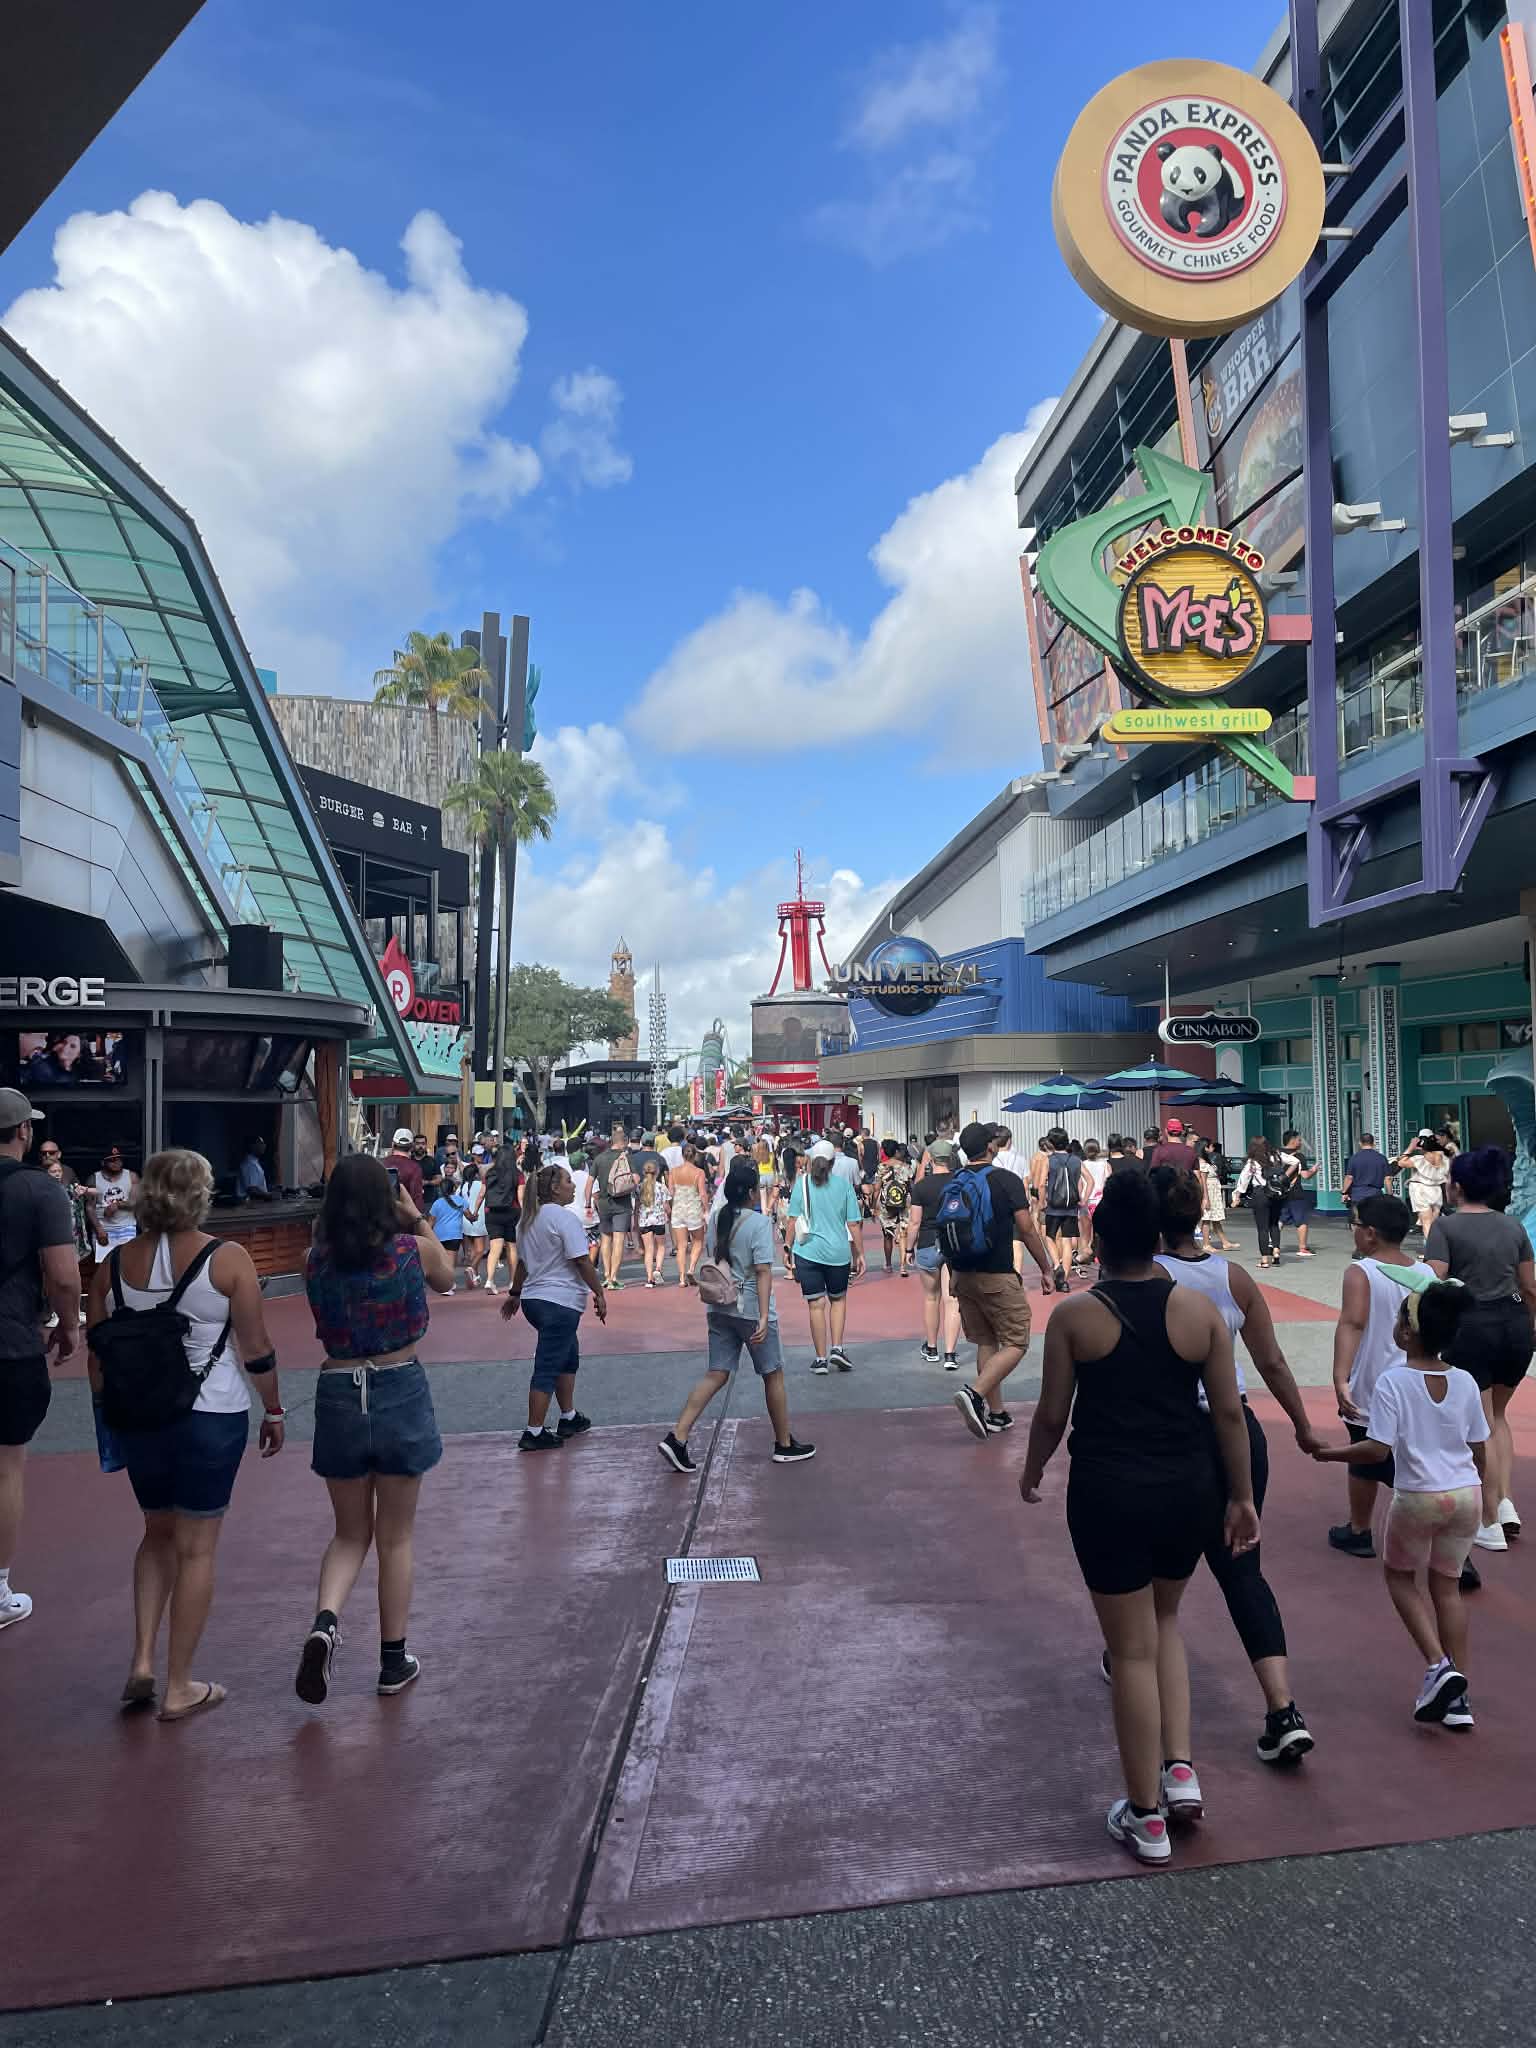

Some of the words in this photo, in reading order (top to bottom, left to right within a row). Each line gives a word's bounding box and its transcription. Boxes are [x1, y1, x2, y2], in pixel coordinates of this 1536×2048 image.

[1113, 107, 1179, 184] PANDA
[1187, 103, 1278, 186] EXPRESS
[1117, 199, 1176, 262] GOURMET
[1183, 241, 1249, 268] CHINESE
[1247, 202, 1276, 245] FOOD
[1219, 317, 1266, 384] WHOPPER
[1223, 336, 1272, 419] BAR
[1117, 526, 1231, 573] WELCOME
[1233, 541, 1265, 573] TO
[1124, 713, 1215, 729] southwest
[1222, 712, 1260, 730] grill
[319, 795, 365, 821] BURGER
[392, 817, 413, 836] BAR
[832, 960, 984, 985] UNIVERSAL
[392, 980, 404, 1002] R
[861, 985, 918, 995] STUDIOS
[413, 997, 462, 1022] OVEN
[1172, 1023, 1254, 1038] CINNABON
